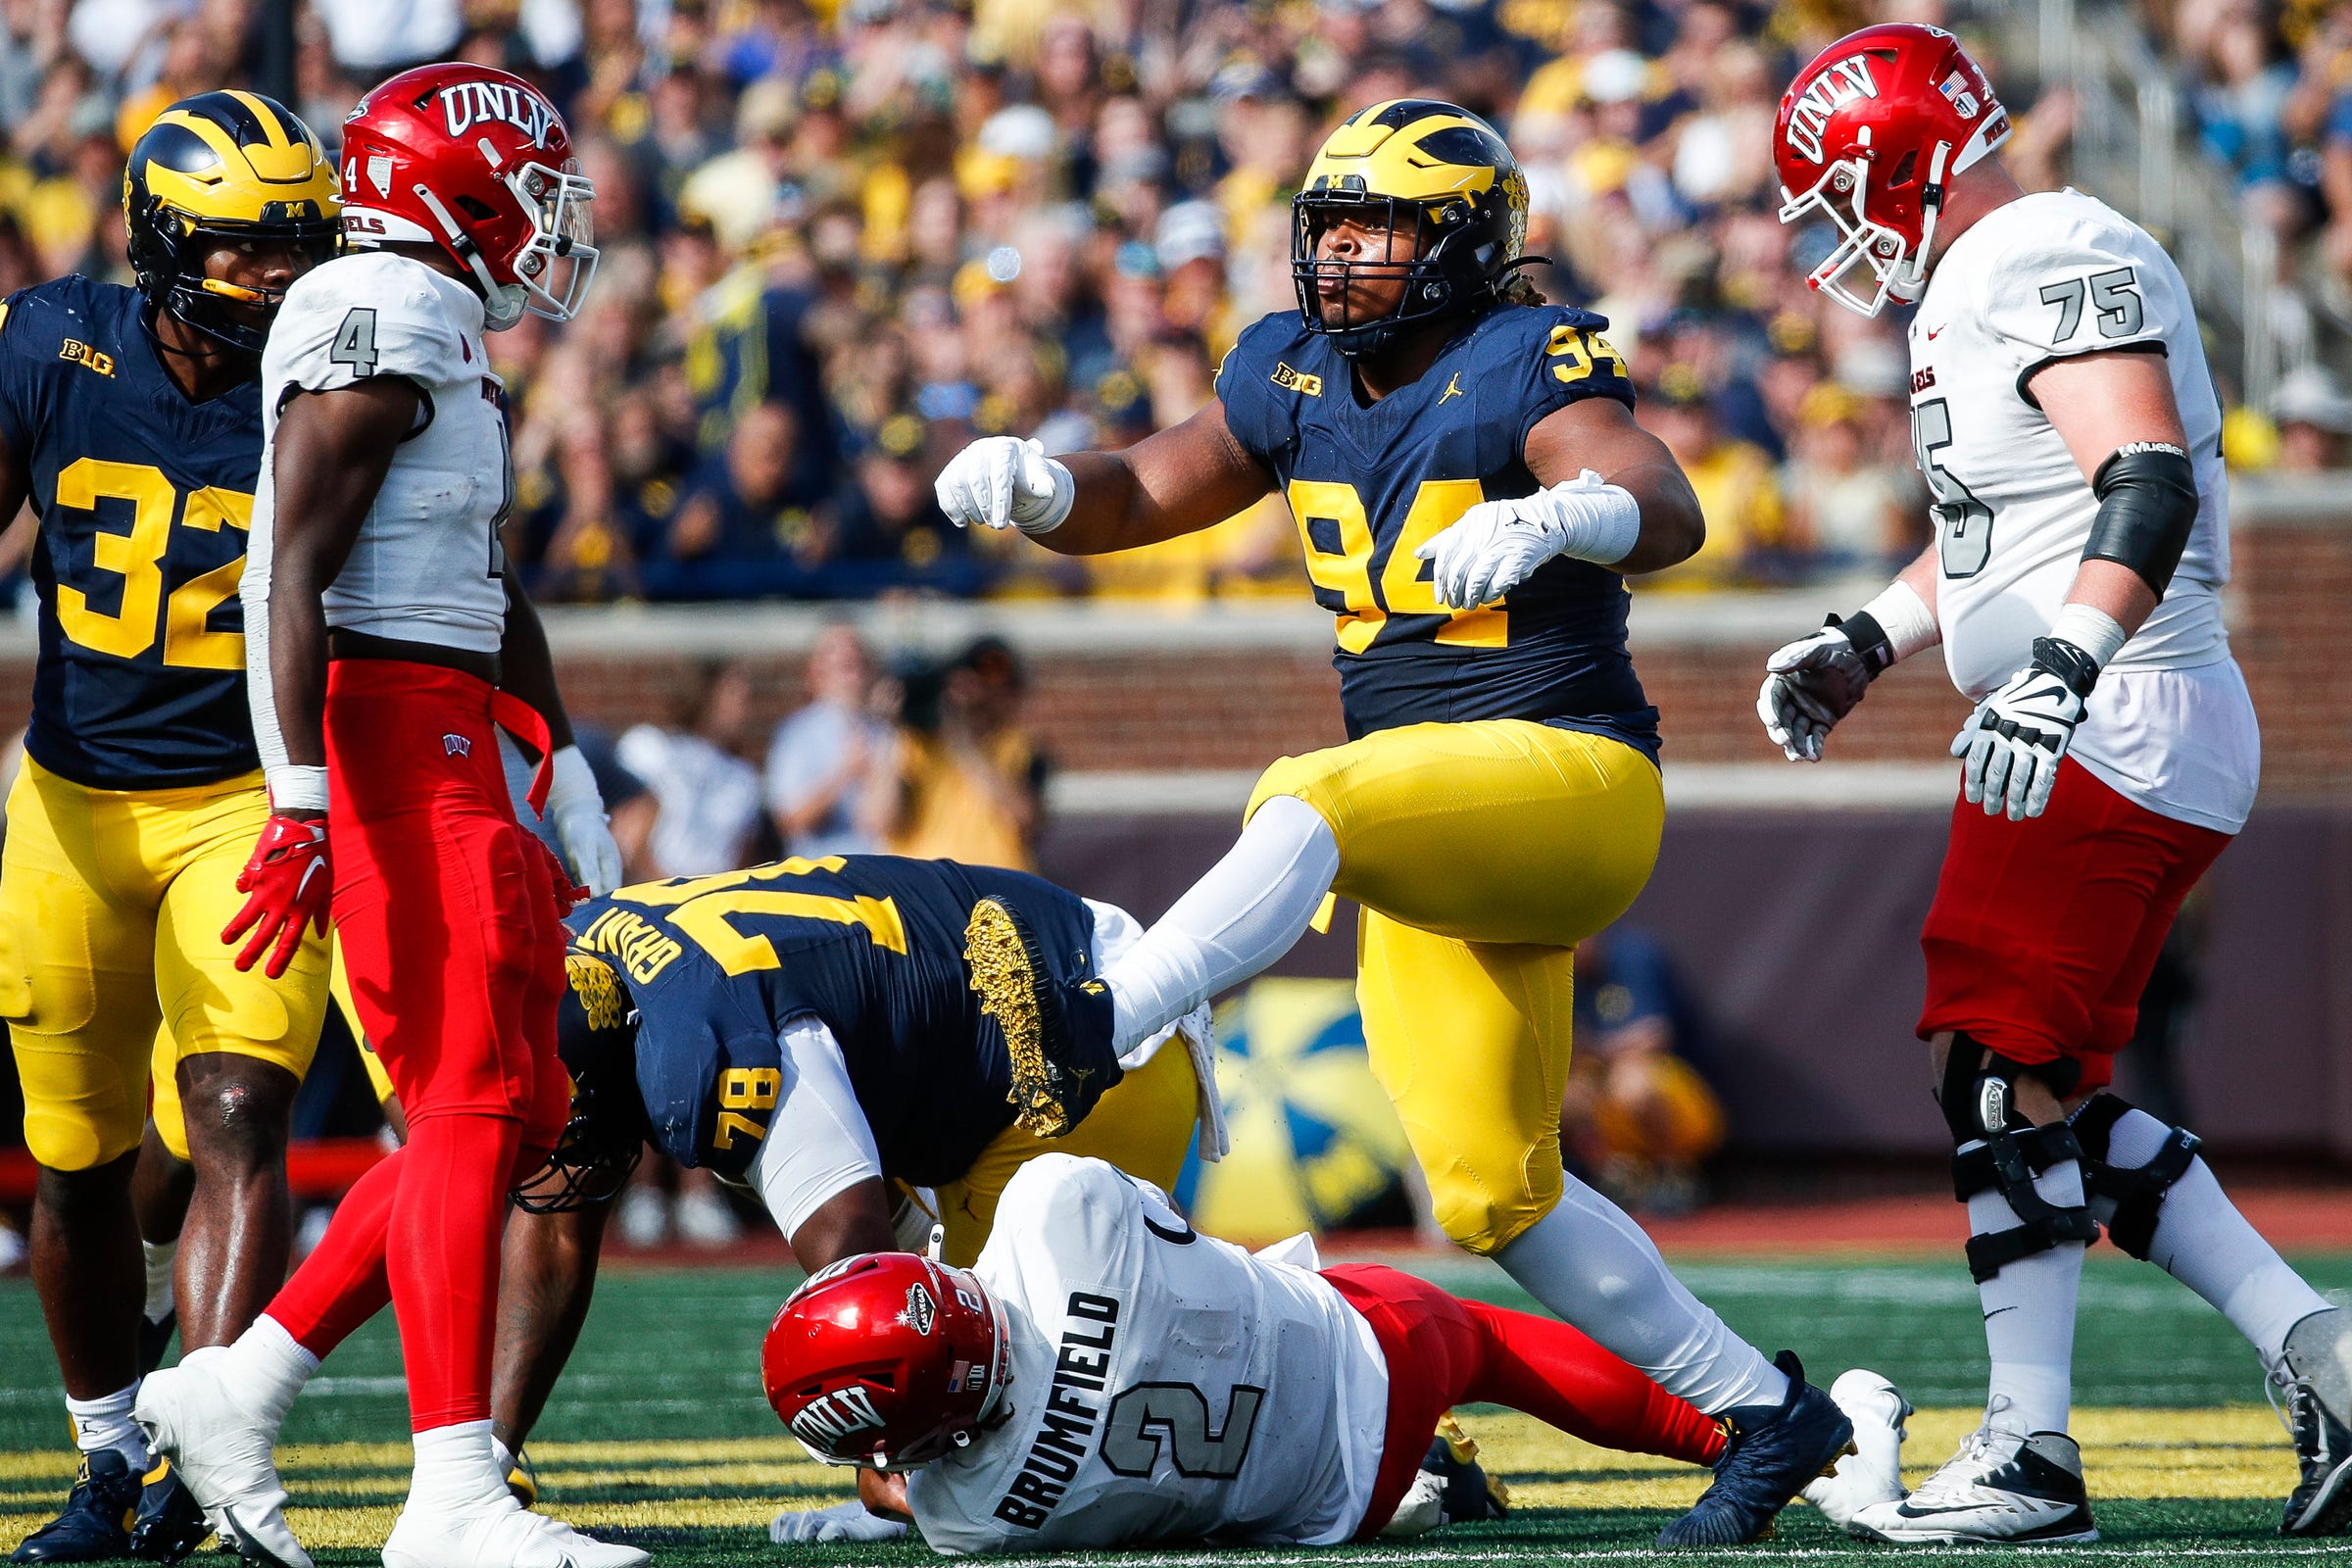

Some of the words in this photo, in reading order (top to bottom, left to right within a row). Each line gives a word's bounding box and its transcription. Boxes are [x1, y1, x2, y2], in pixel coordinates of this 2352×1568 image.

[439, 81, 555, 151] UNLV
[1786, 53, 1879, 166] UNLV
[285, 202, 306, 219] M
[345, 157, 357, 192] 4
[343, 216, 387, 235] ELS
[329, 307, 380, 378] 4
[2038, 266, 2144, 346] 75
[1545, 324, 1629, 383] 94
[56, 456, 256, 670] 32
[1287, 477, 1509, 656] 94
[442, 733, 471, 760] UNLV
[574, 906, 684, 987] GRANT
[712, 1067, 783, 1151] 78
[791, 1384, 887, 1457] UNLV
[992, 1291, 1120, 1531] BRUMFIELD
[1098, 1380, 1266, 1480] 2
